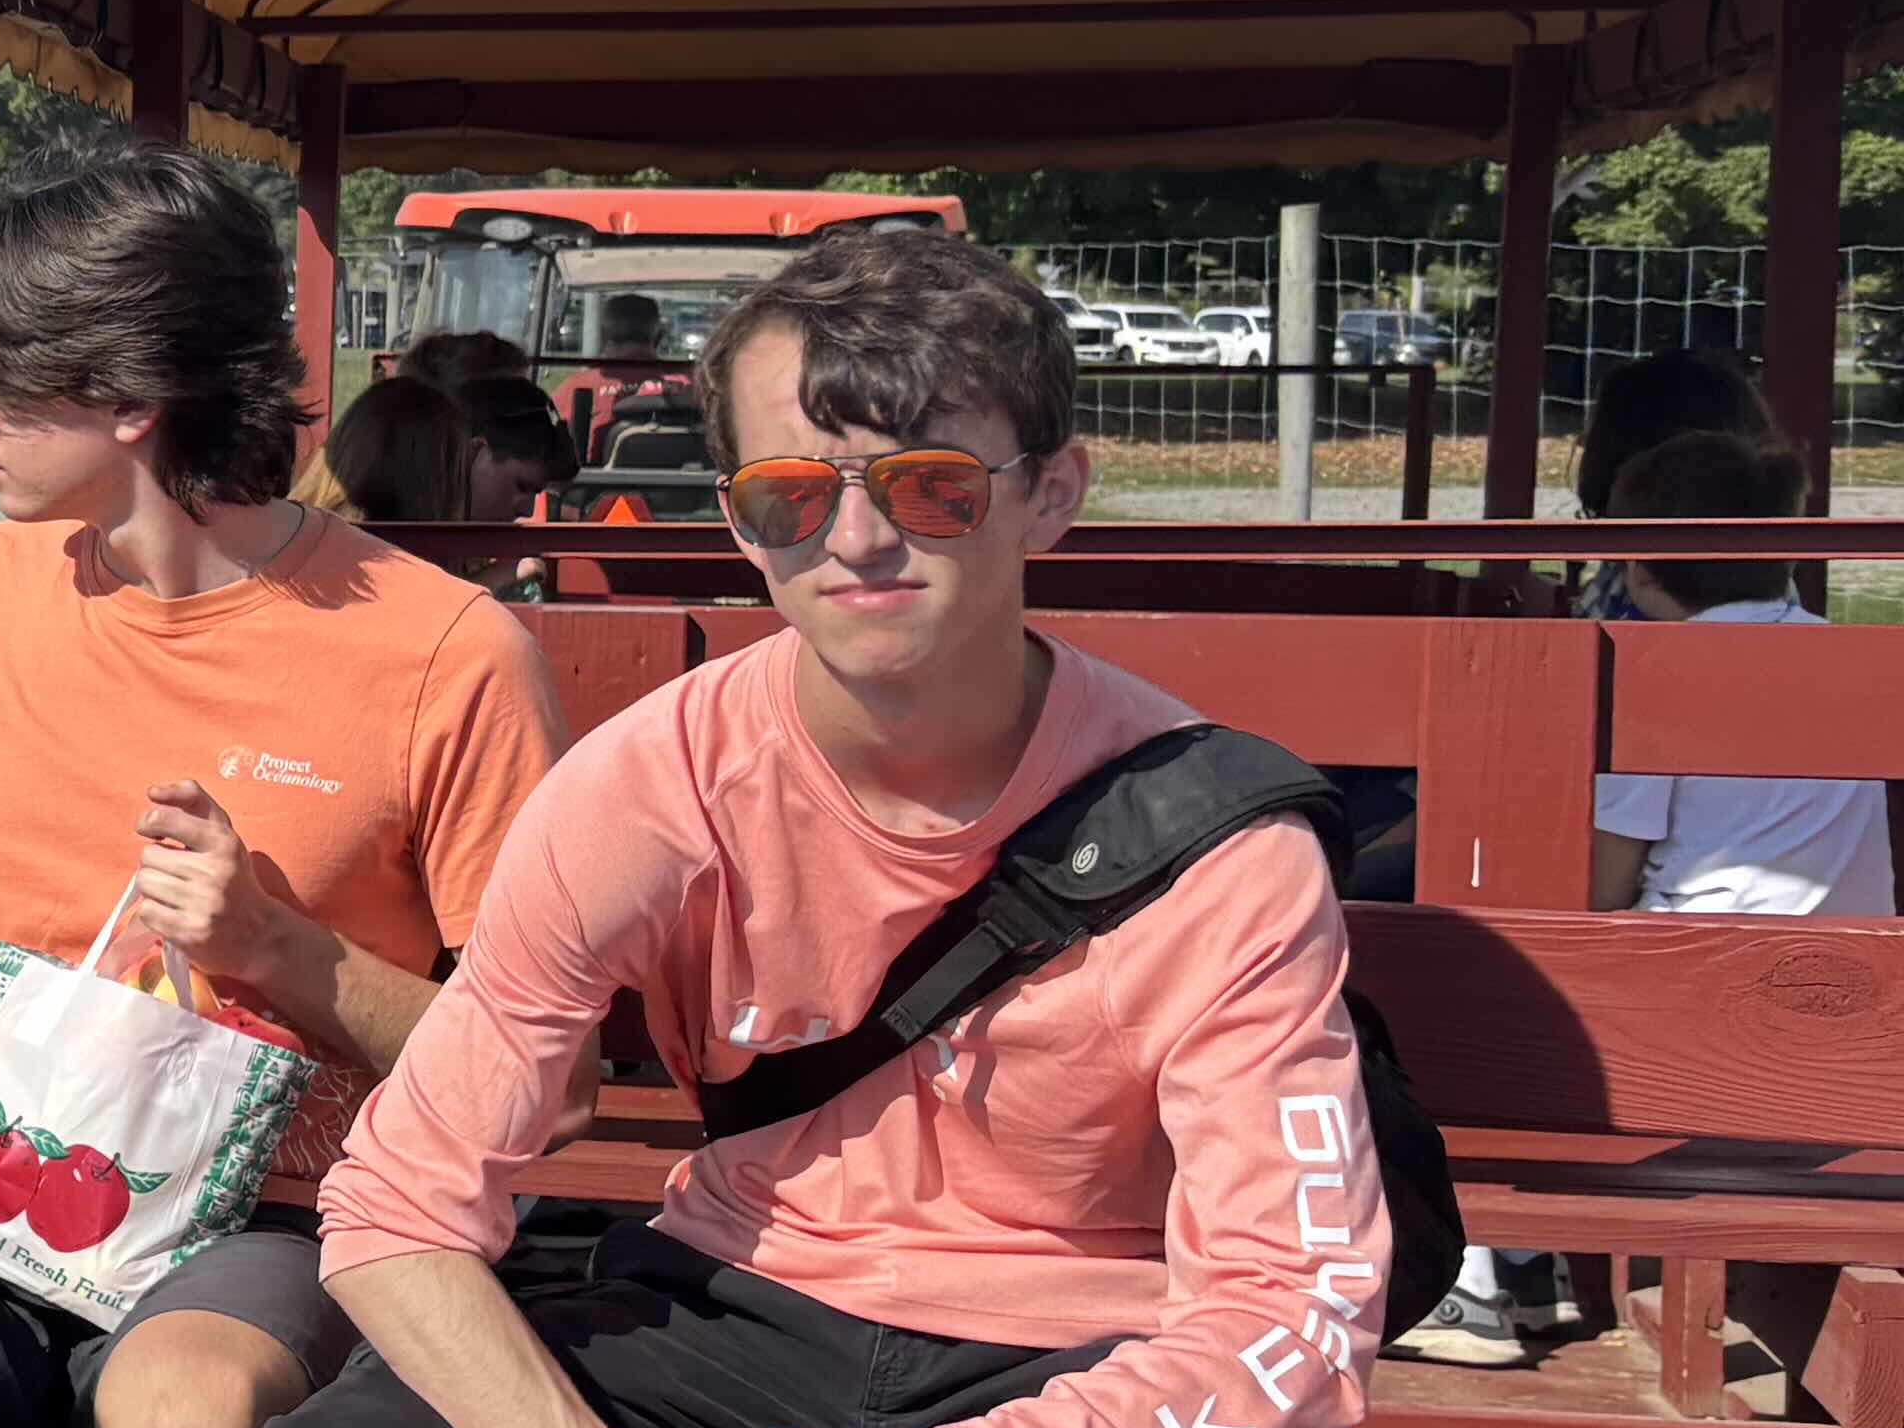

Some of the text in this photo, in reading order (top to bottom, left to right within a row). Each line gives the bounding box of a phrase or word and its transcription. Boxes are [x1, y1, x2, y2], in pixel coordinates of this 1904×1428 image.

[259, 752, 312, 773] Project
[252, 766, 344, 795] Oceanology
[11, 1245, 69, 1287] Fresh
[72, 1277, 127, 1310] Fruit
